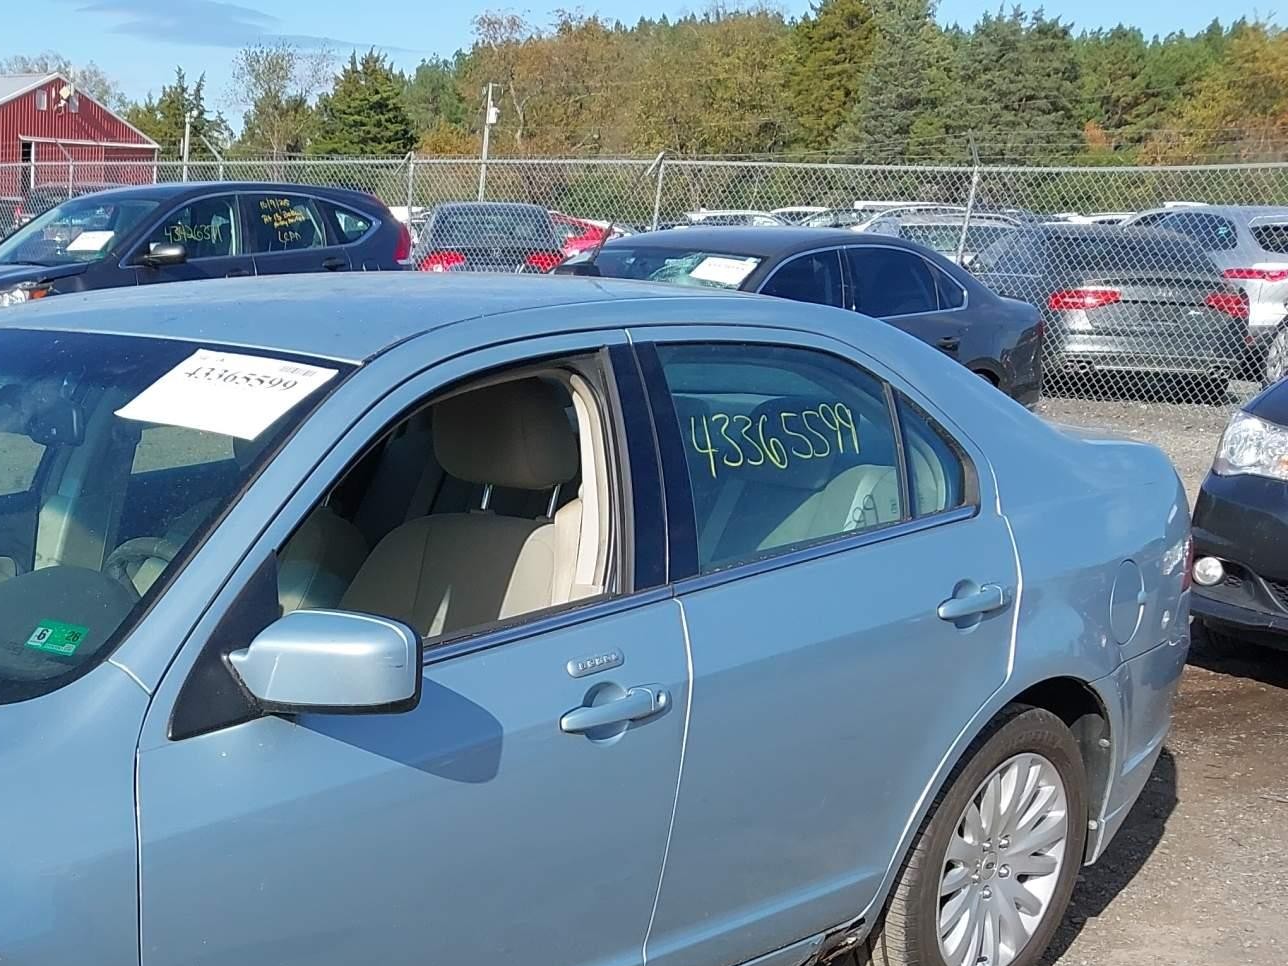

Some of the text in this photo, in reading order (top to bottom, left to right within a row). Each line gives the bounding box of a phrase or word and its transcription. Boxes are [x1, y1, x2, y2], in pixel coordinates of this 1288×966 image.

[183, 366, 299, 391] 43365599
[690, 402, 860, 479] 43365599
[37, 628, 49, 641] 6
